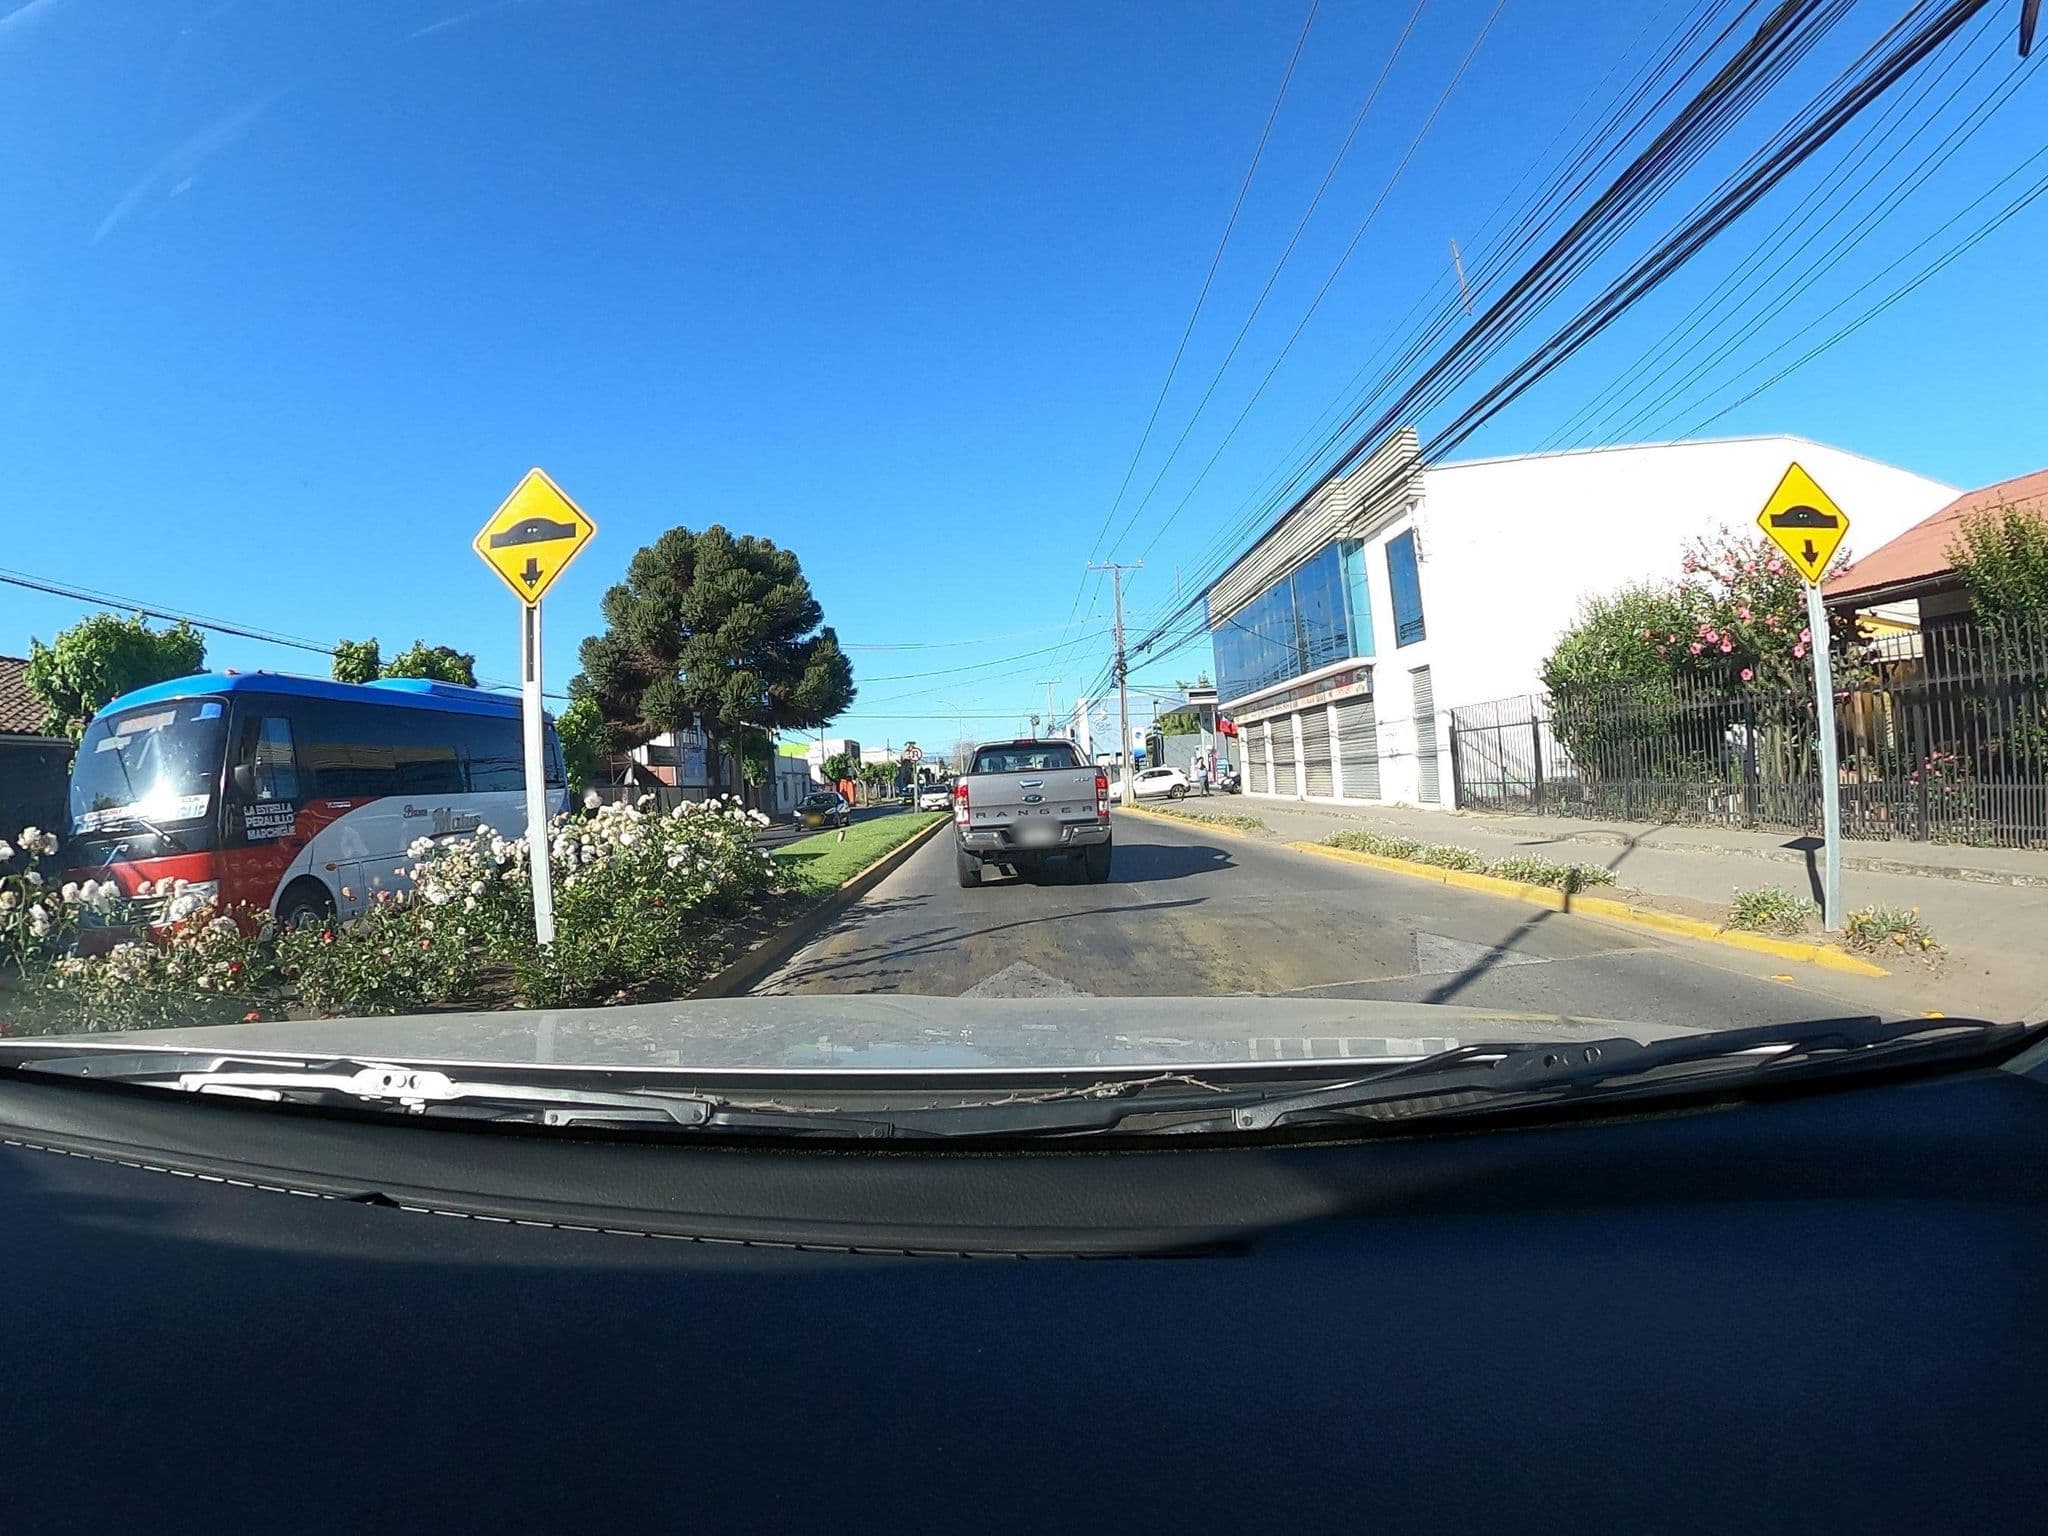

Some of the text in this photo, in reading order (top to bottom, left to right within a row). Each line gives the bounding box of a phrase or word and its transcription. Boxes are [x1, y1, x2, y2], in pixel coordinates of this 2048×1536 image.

[243, 803, 293, 816] LA ESTRELLA
[976, 805, 1093, 819] RANGER
[245, 814, 294, 828] PERALILLO
